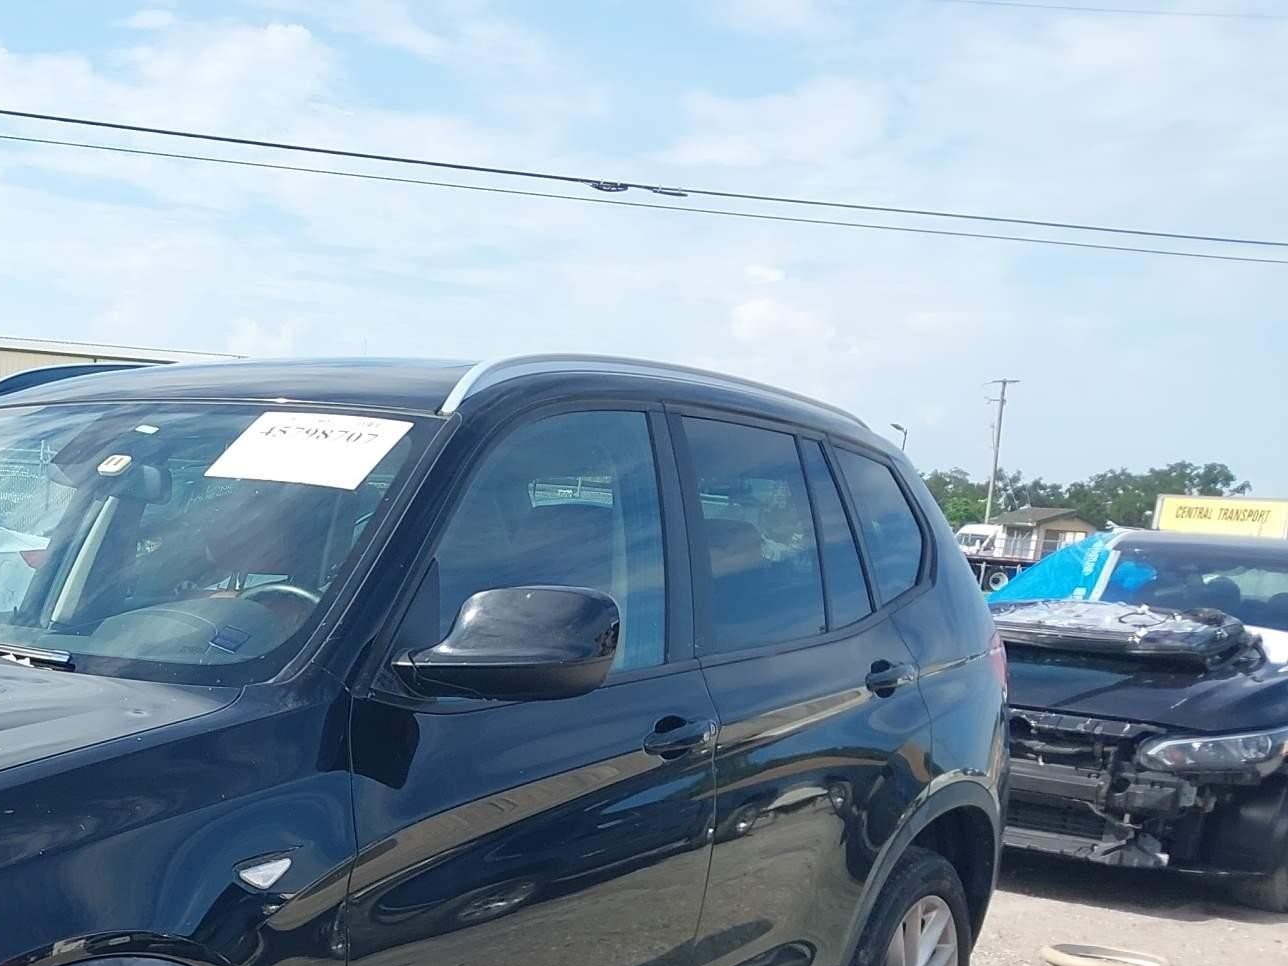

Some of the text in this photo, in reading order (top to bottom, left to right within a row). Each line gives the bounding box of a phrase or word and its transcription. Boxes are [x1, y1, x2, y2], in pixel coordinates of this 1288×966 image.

[260, 425, 379, 443] 45798707
[1175, 505, 1271, 523] CENTRAL TRANSPORT
